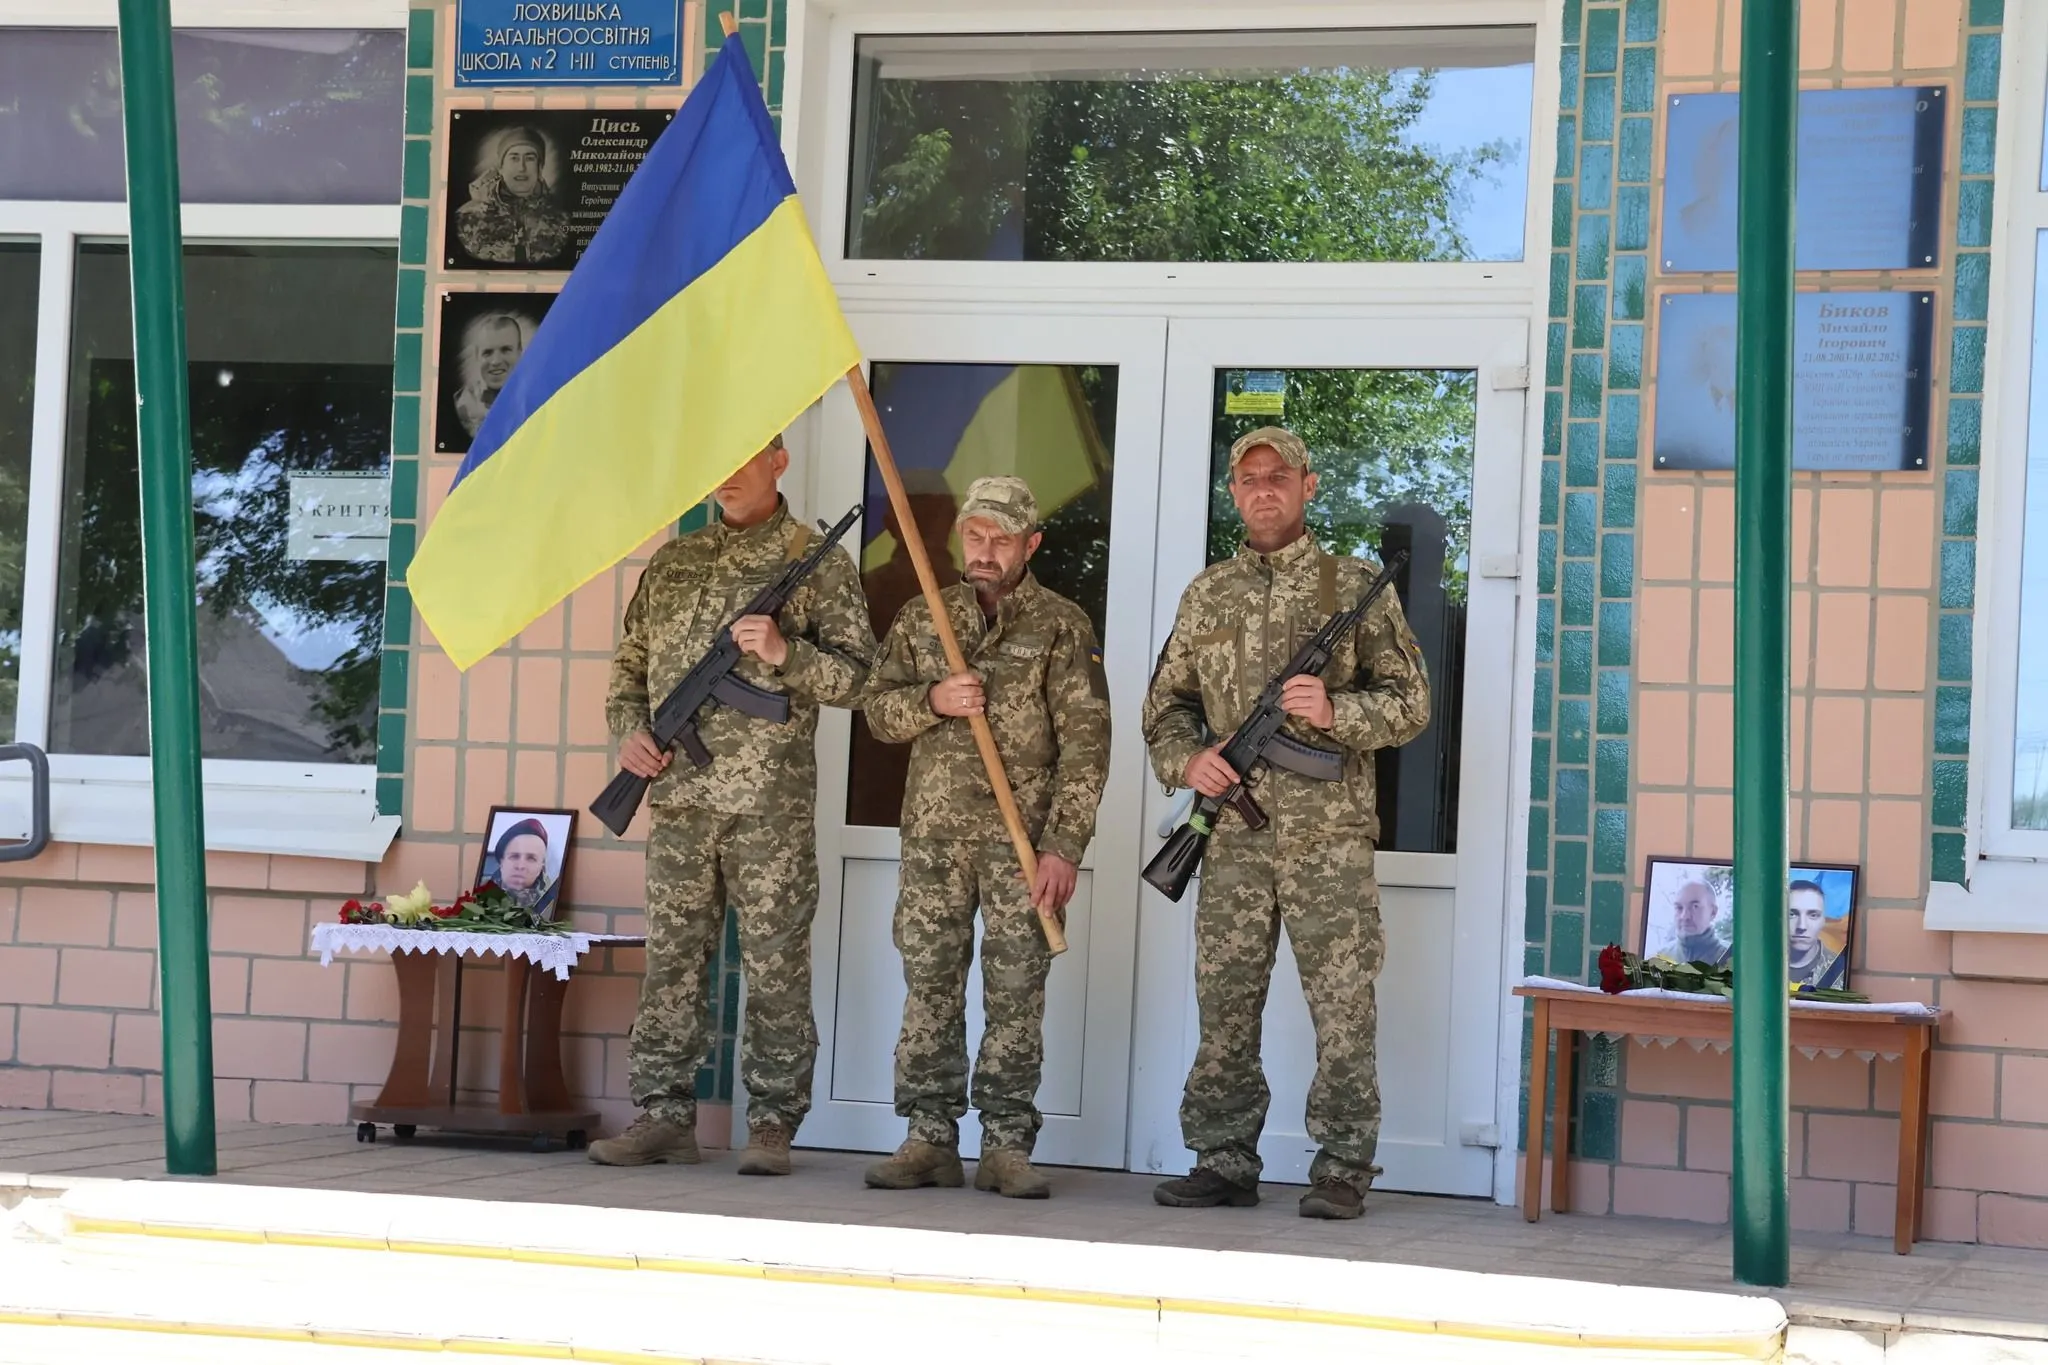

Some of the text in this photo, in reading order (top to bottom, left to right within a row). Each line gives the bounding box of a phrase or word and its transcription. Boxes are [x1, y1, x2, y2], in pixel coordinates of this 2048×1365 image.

[513, 3, 622, 22] ЛОХВИЦЬКА
[483, 25, 650, 46] ЗАГАЛЬНООСВІТНЯ
[462, 52, 522, 71] ШКОЛА
[608, 54, 670, 70] СТУПЕНІВ
[590, 118, 641, 135] Цись
[581, 136, 649, 148] Олександр
[1818, 303, 1889, 318] Биков
[1818, 322, 1888, 334] Михайло
